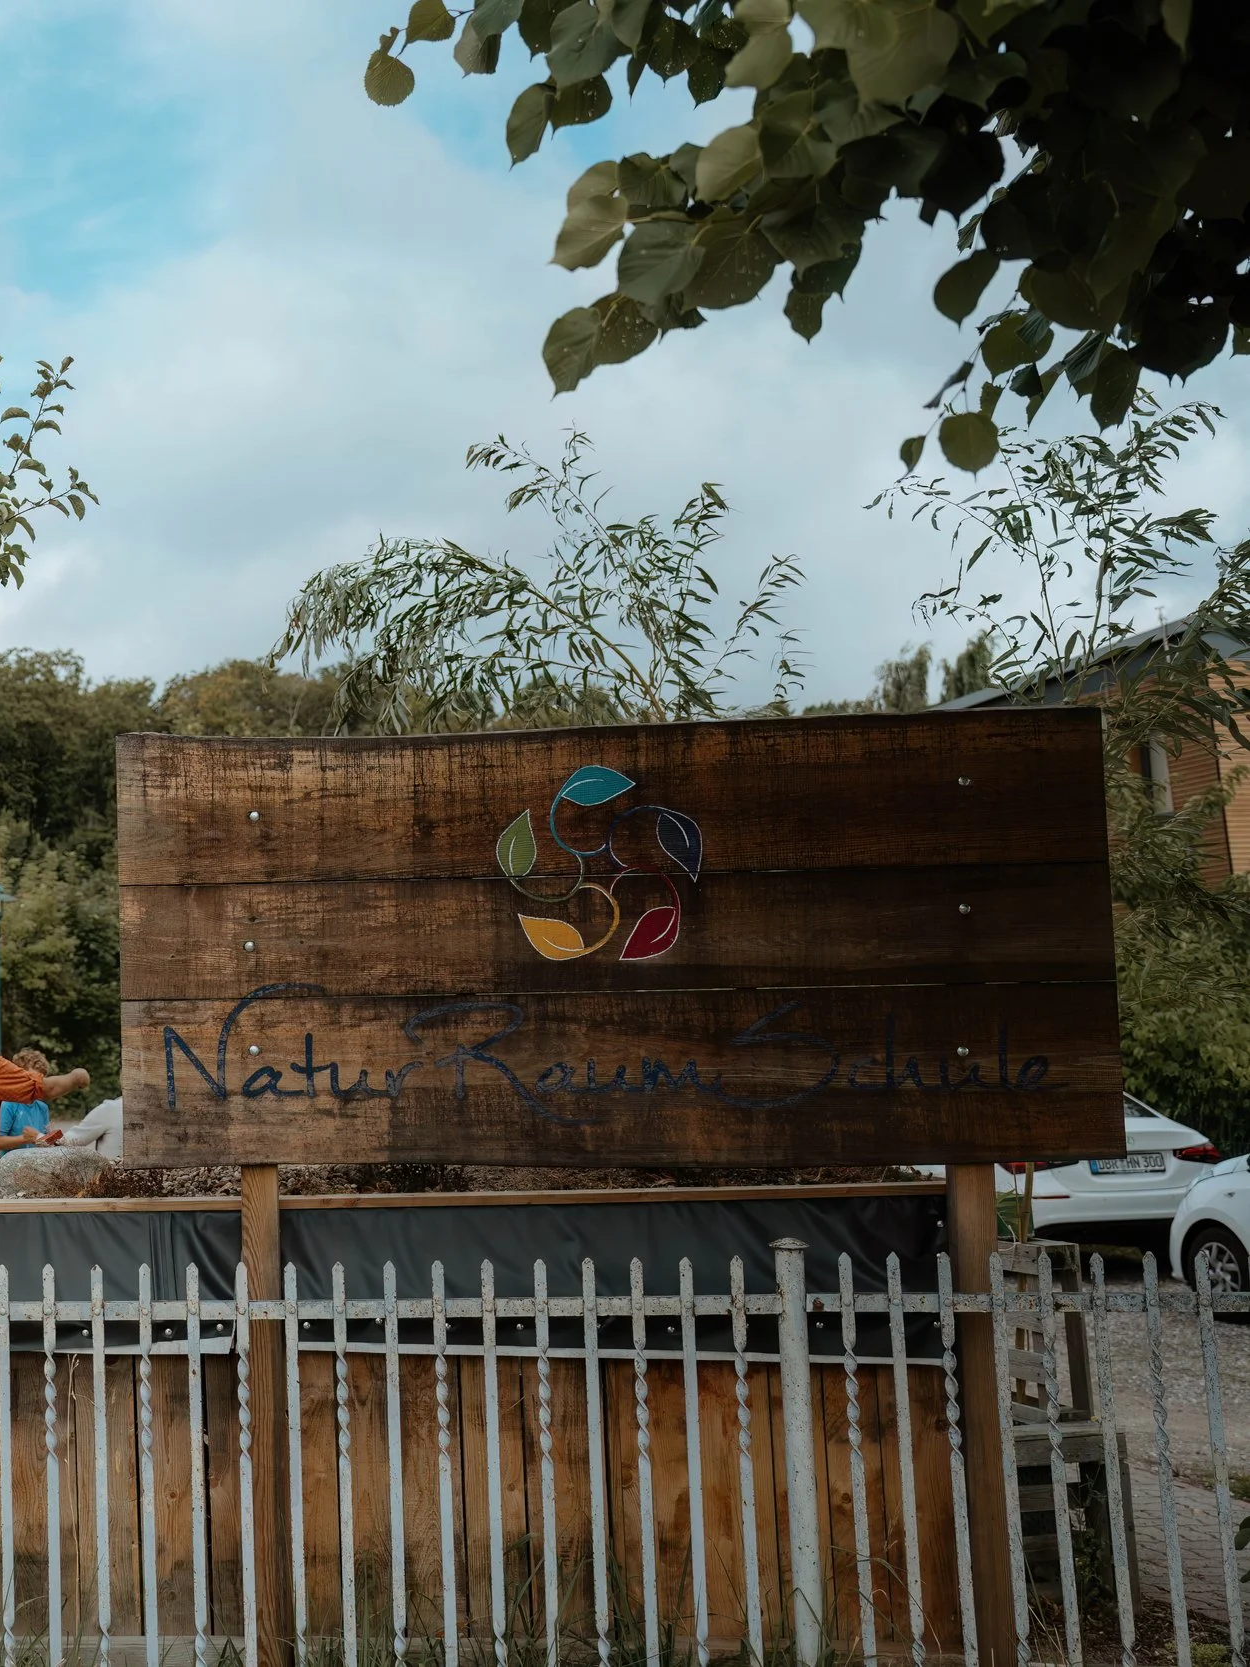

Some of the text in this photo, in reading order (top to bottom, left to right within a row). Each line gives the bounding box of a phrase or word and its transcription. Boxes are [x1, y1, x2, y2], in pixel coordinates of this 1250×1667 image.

[163, 983, 1070, 1125] Natur Raum Schule
